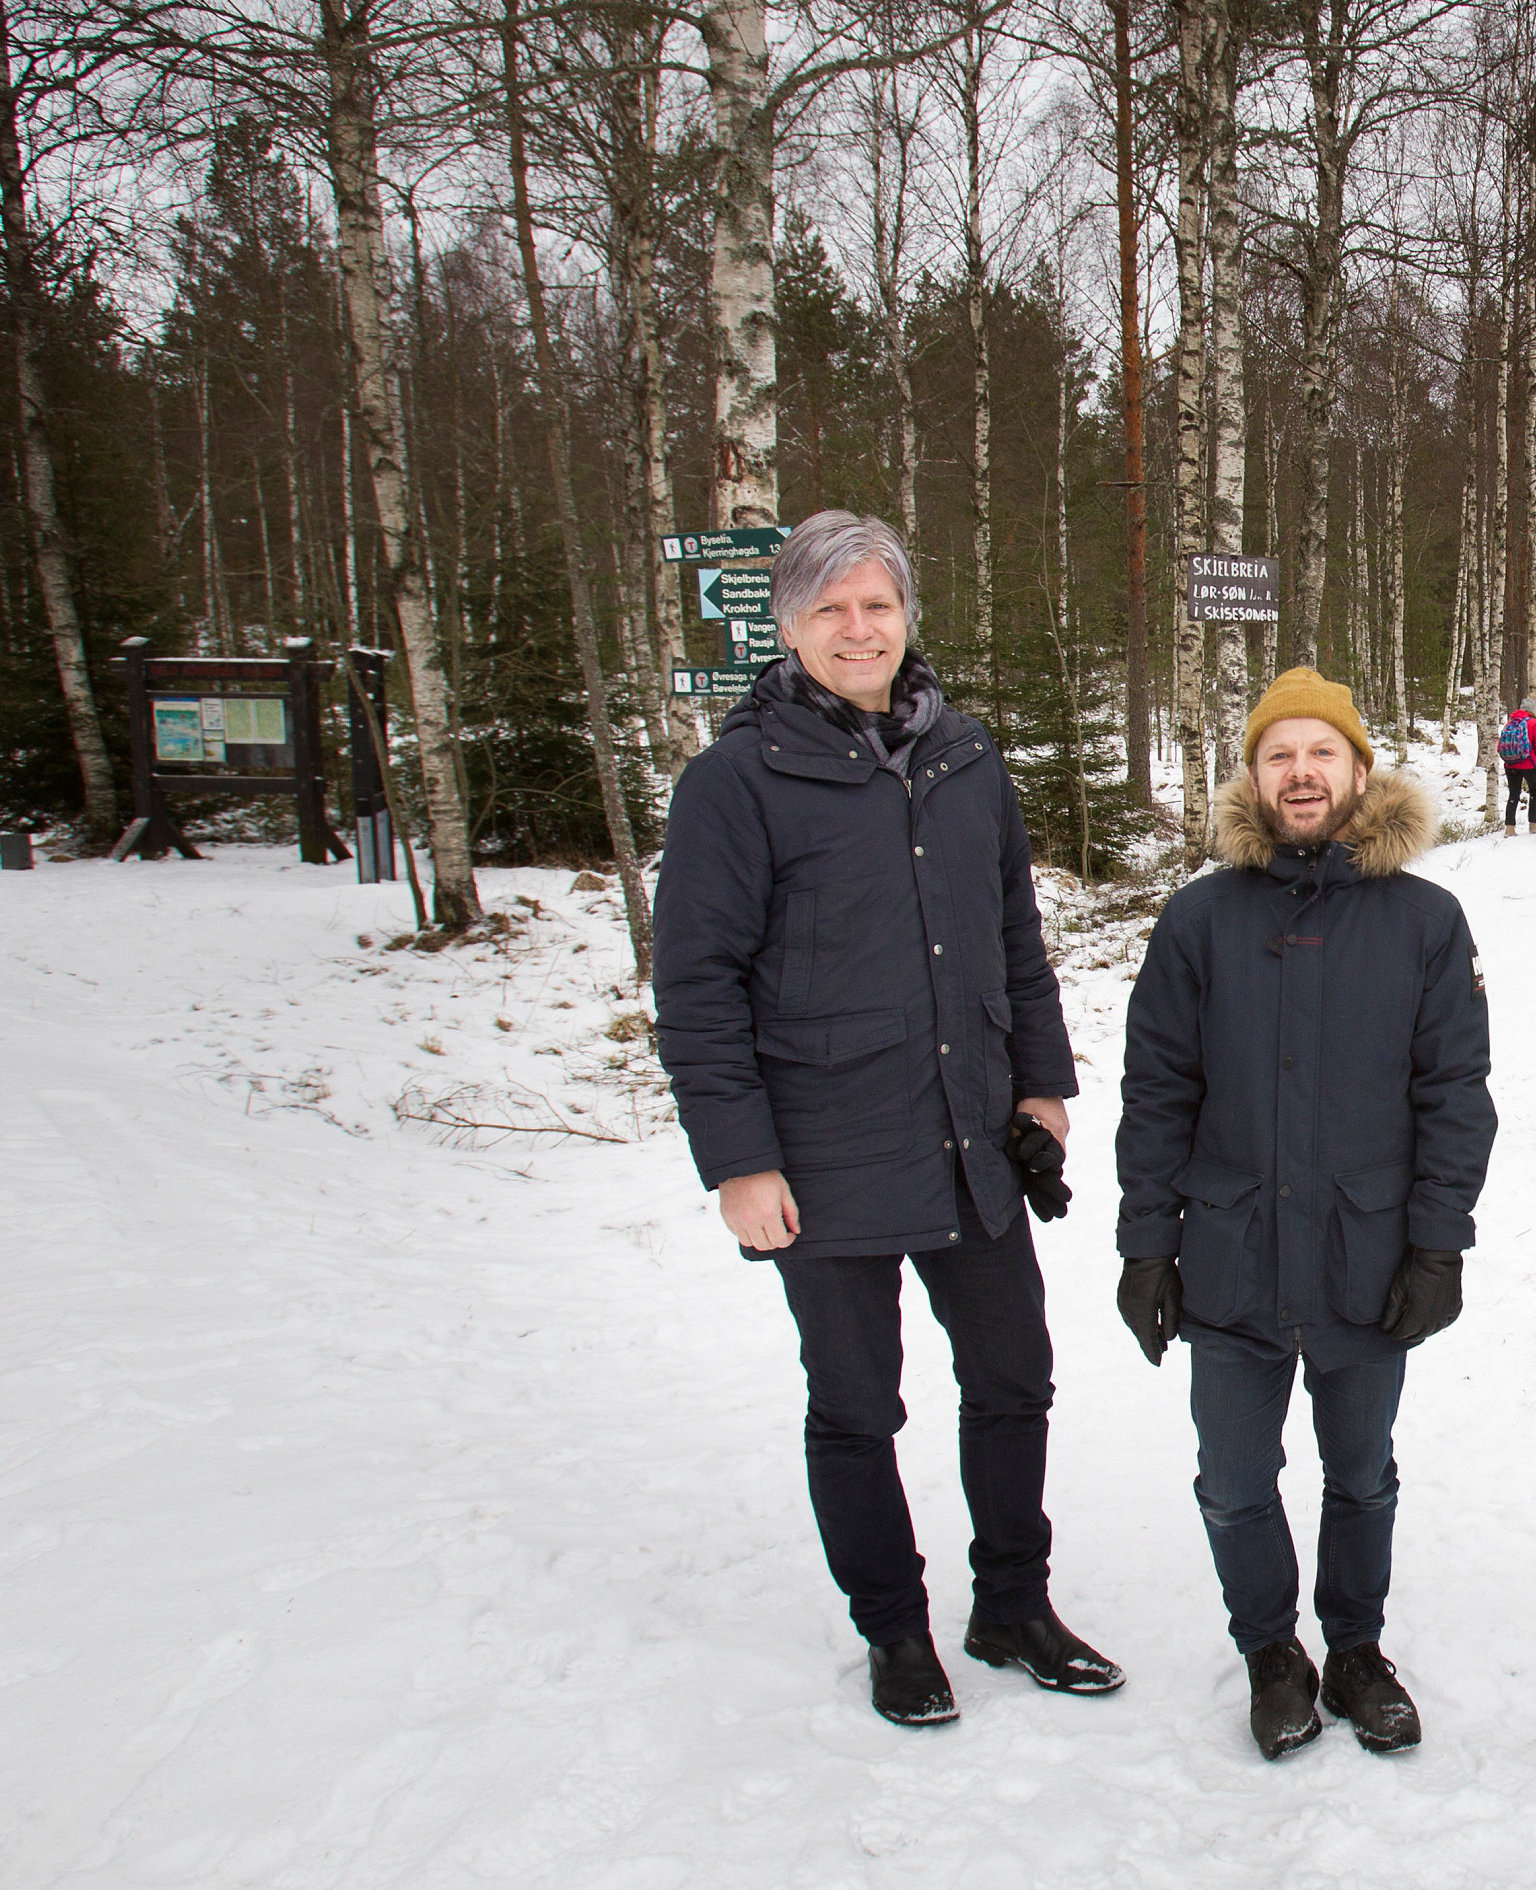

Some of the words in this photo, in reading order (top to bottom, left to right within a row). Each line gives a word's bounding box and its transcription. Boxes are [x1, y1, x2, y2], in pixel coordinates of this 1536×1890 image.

[703, 546, 760, 558] Kjerringhøgda
[1193, 556, 1268, 578] SKJELBREIA
[721, 575, 769, 585] Skjelbreia
[723, 603, 761, 613] Krokhol
[1204, 603, 1278, 621] SKISESONGEN
[748, 622, 776, 633] Vangen
[713, 672, 747, 682] Øvresaga
